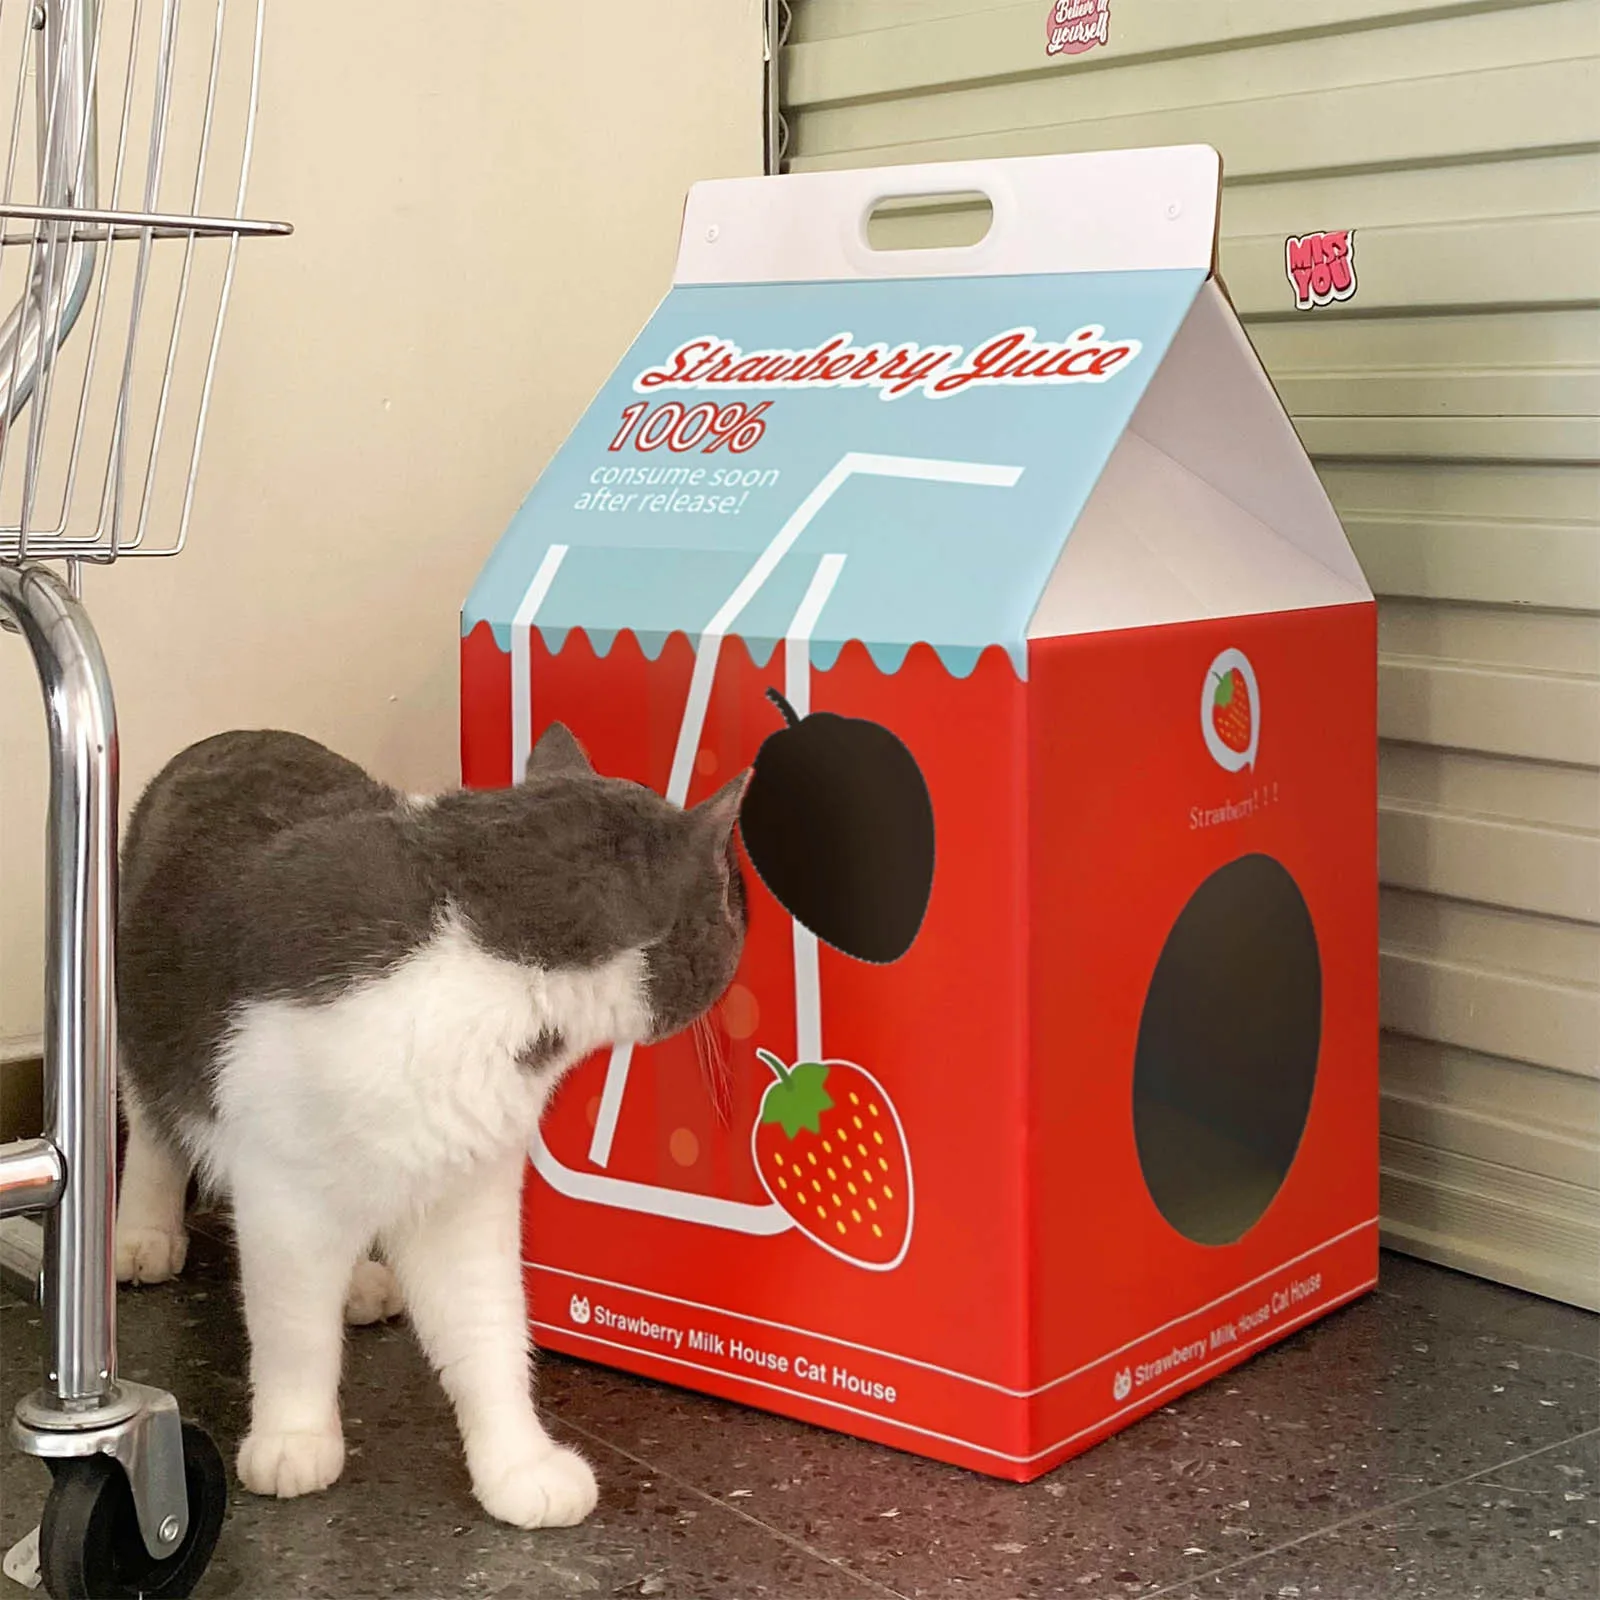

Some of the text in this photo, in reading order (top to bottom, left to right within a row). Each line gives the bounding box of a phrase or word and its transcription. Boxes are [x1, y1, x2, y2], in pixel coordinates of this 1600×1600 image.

[1048, 11, 1109, 53] yourself
[1055, 0, 1095, 23] Believe
[1289, 230, 1349, 272] MISS
[1293, 256, 1352, 302] YOU
[638, 329, 1133, 395] Strawberry Juice
[608, 400, 775, 455] 100%
[589, 465, 781, 488] consume soon
[573, 486, 751, 516] after release!
[1133, 1337, 1208, 1387] Strawberry
[1209, 1321, 1238, 1351] Milk
[1271, 1287, 1290, 1315] Cat
[1290, 1272, 1322, 1305] House
[594, 1304, 897, 1403] Strawberry Milk House Cat House
